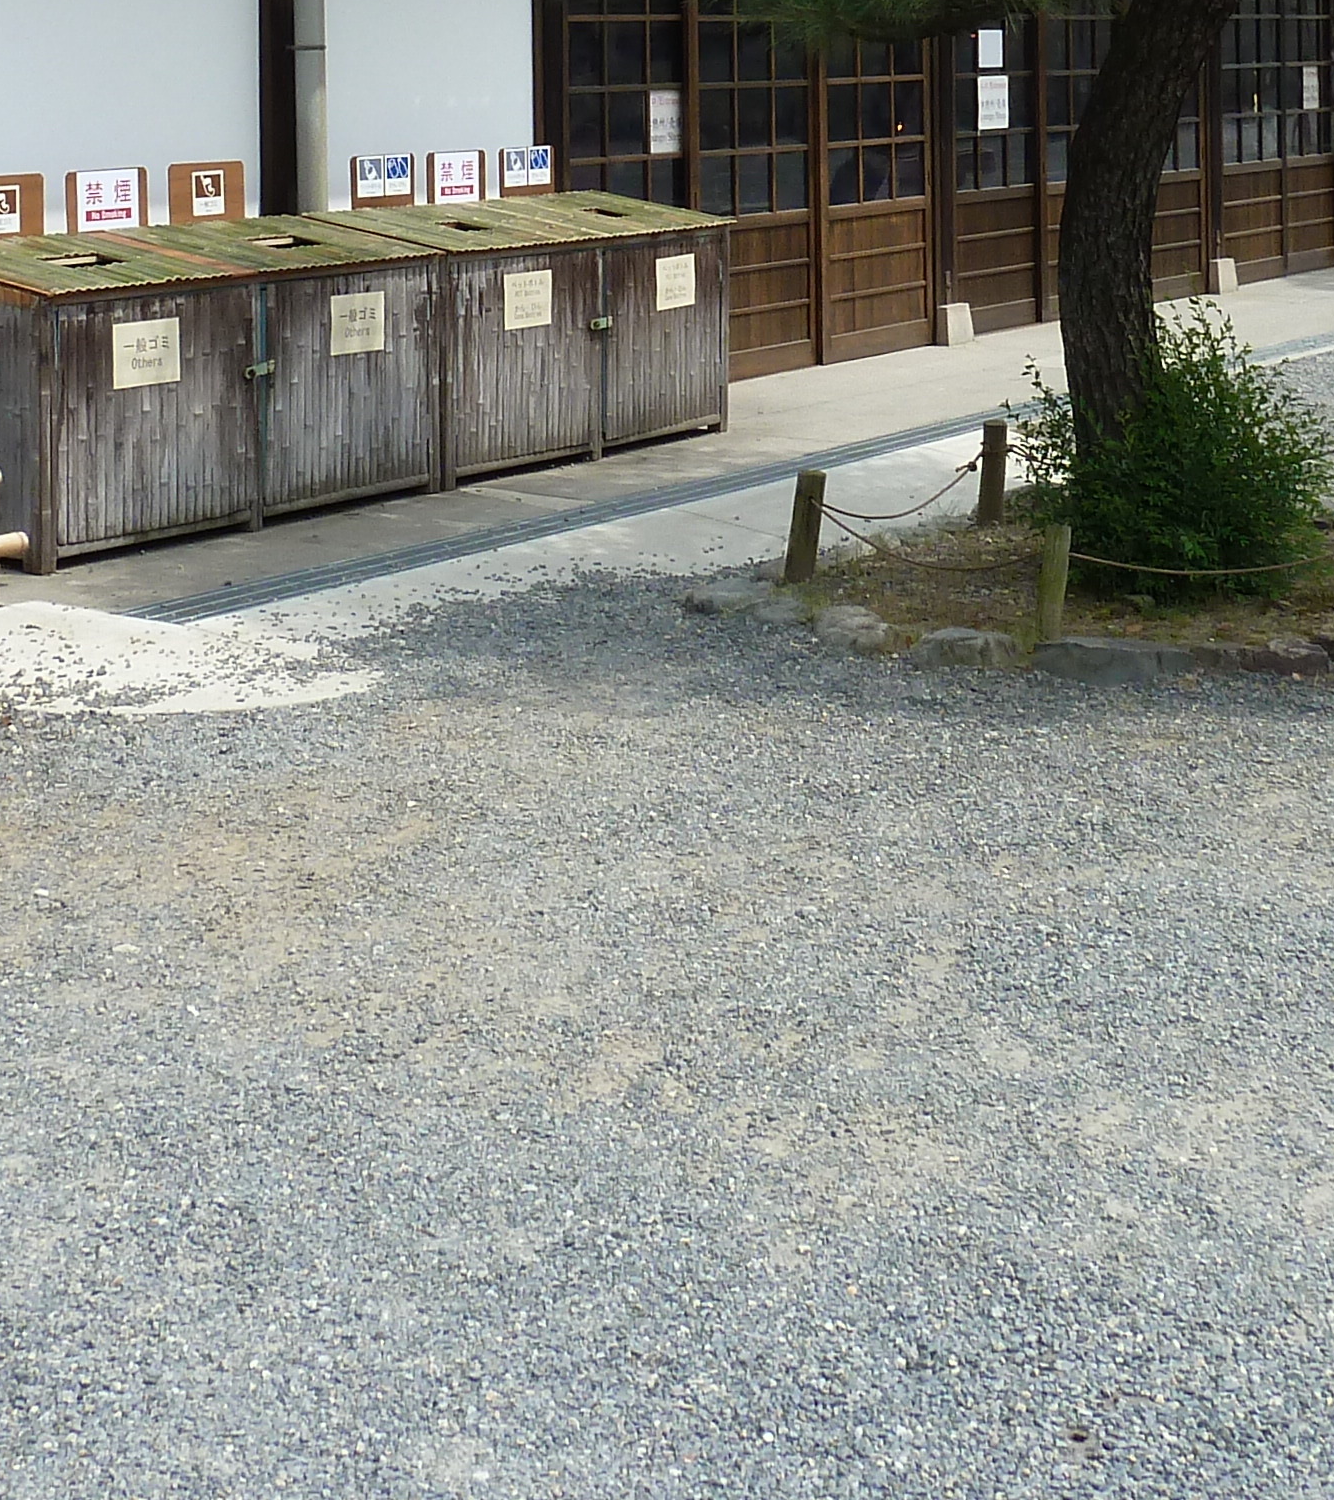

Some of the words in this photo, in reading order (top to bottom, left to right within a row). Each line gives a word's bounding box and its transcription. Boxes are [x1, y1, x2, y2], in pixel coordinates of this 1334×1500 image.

[440, 159, 475, 182] 禁煙
[85, 179, 132, 205] 禁煙
[131, 356, 163, 370] Others
